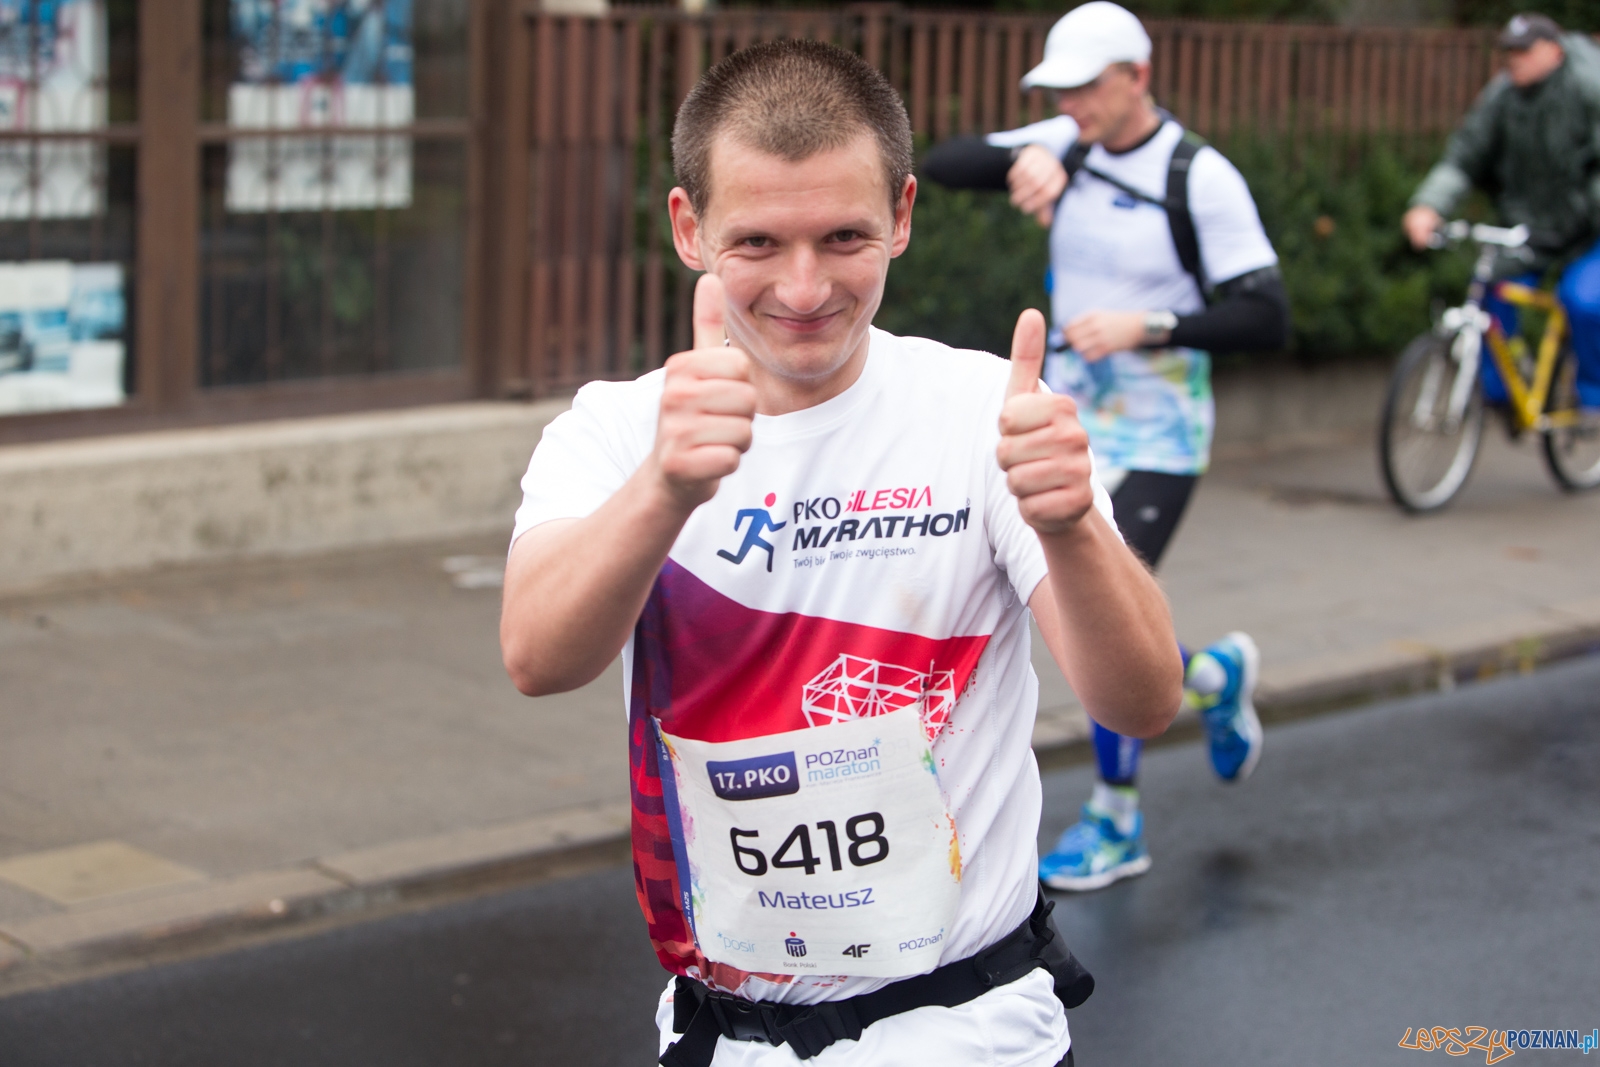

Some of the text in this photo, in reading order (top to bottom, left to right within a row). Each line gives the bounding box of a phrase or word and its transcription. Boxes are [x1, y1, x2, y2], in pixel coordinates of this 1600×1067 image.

[793, 496, 841, 524] PKO
[793, 556, 813, 569] Twój
[715, 771, 742, 790] 17.
[744, 764, 791, 788] PKO
[807, 758, 881, 782] maraton
[729, 811, 889, 876] 6418
[842, 943, 871, 958] 4F
